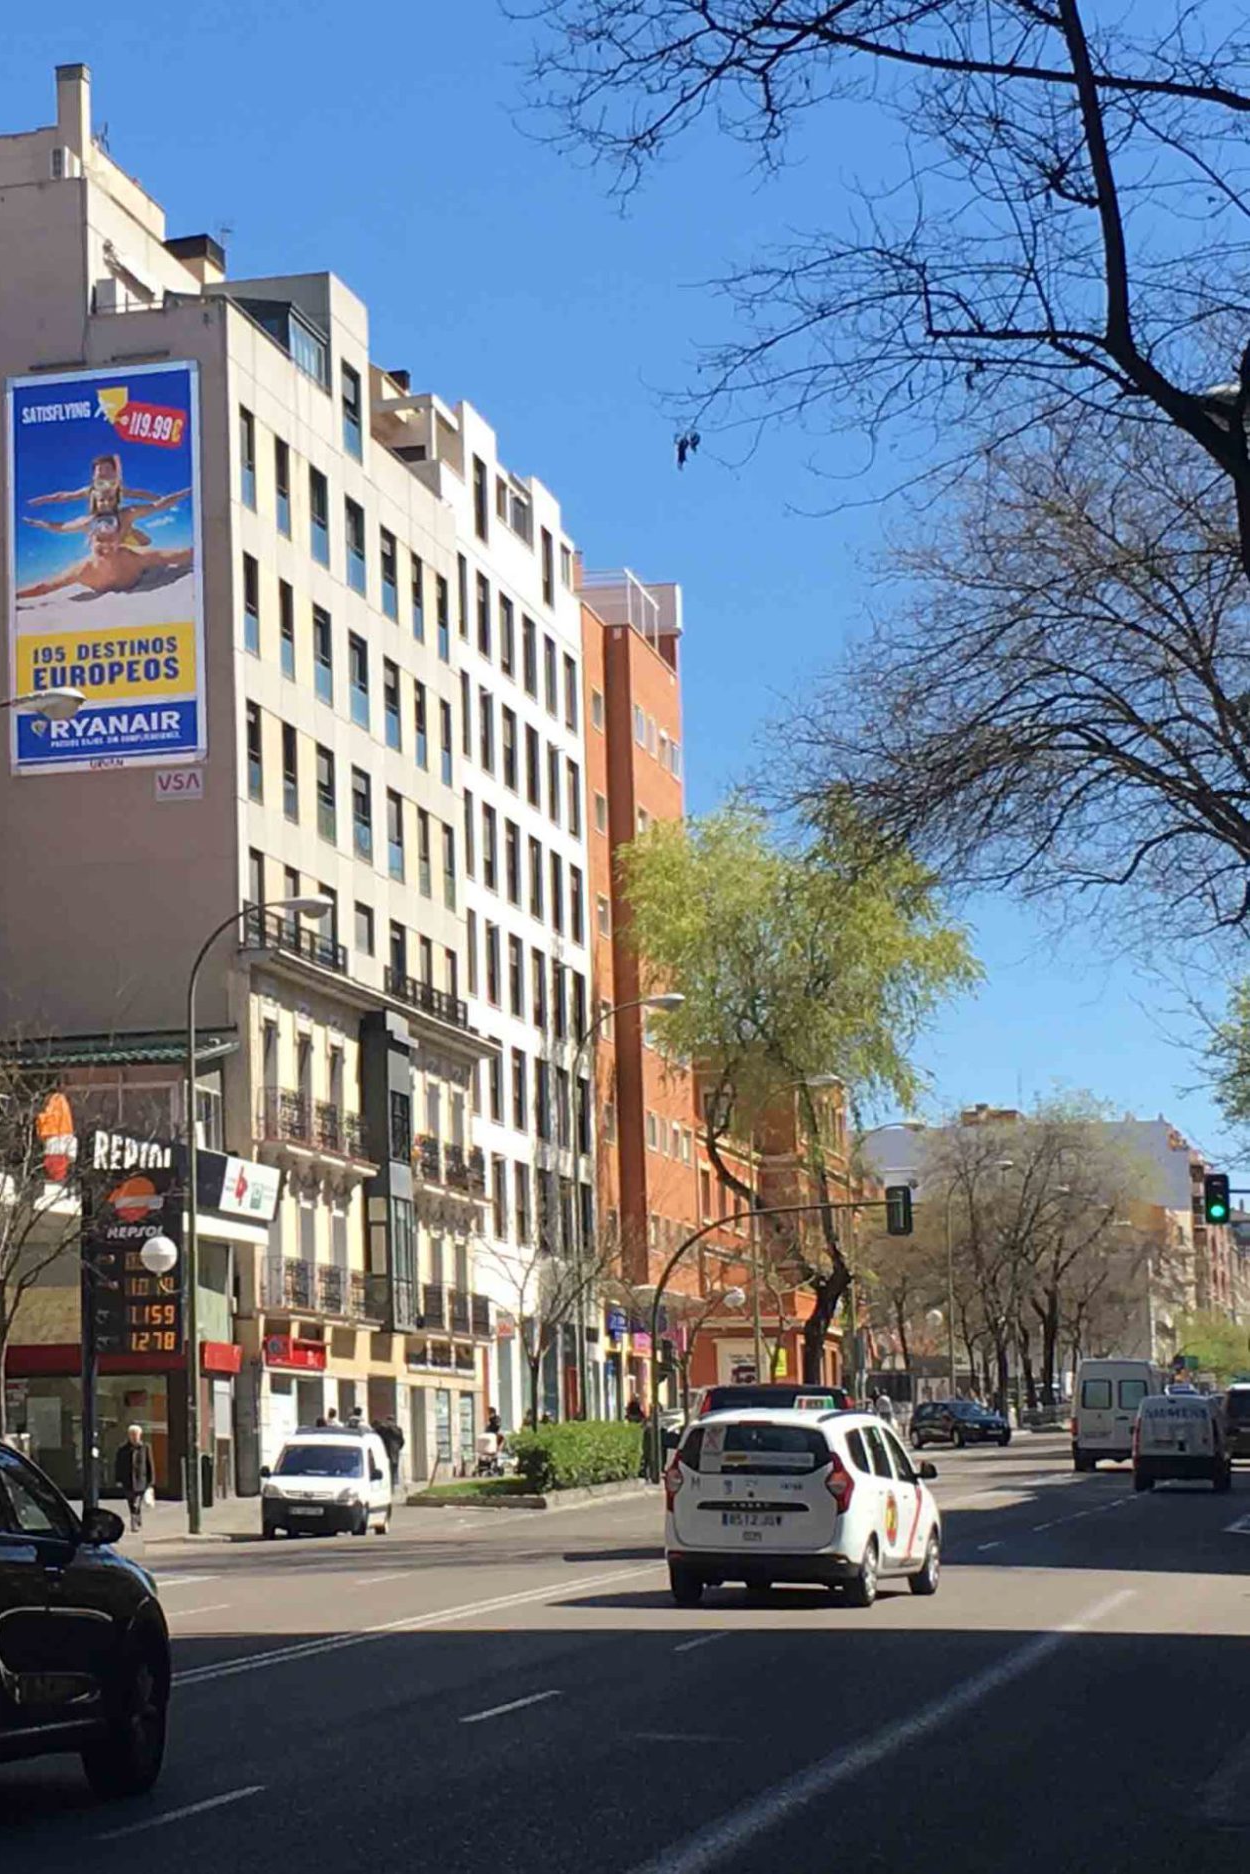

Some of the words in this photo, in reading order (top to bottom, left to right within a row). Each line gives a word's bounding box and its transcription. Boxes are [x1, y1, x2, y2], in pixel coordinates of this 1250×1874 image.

[22, 401, 91, 424] SATISFLYING
[33, 646, 66, 664] 195
[77, 636, 178, 661] DESTINOS
[33, 656, 179, 690] EUROPEOS
[51, 710, 181, 739] RYANAIR
[106, 1225, 164, 1240] REPSOL
